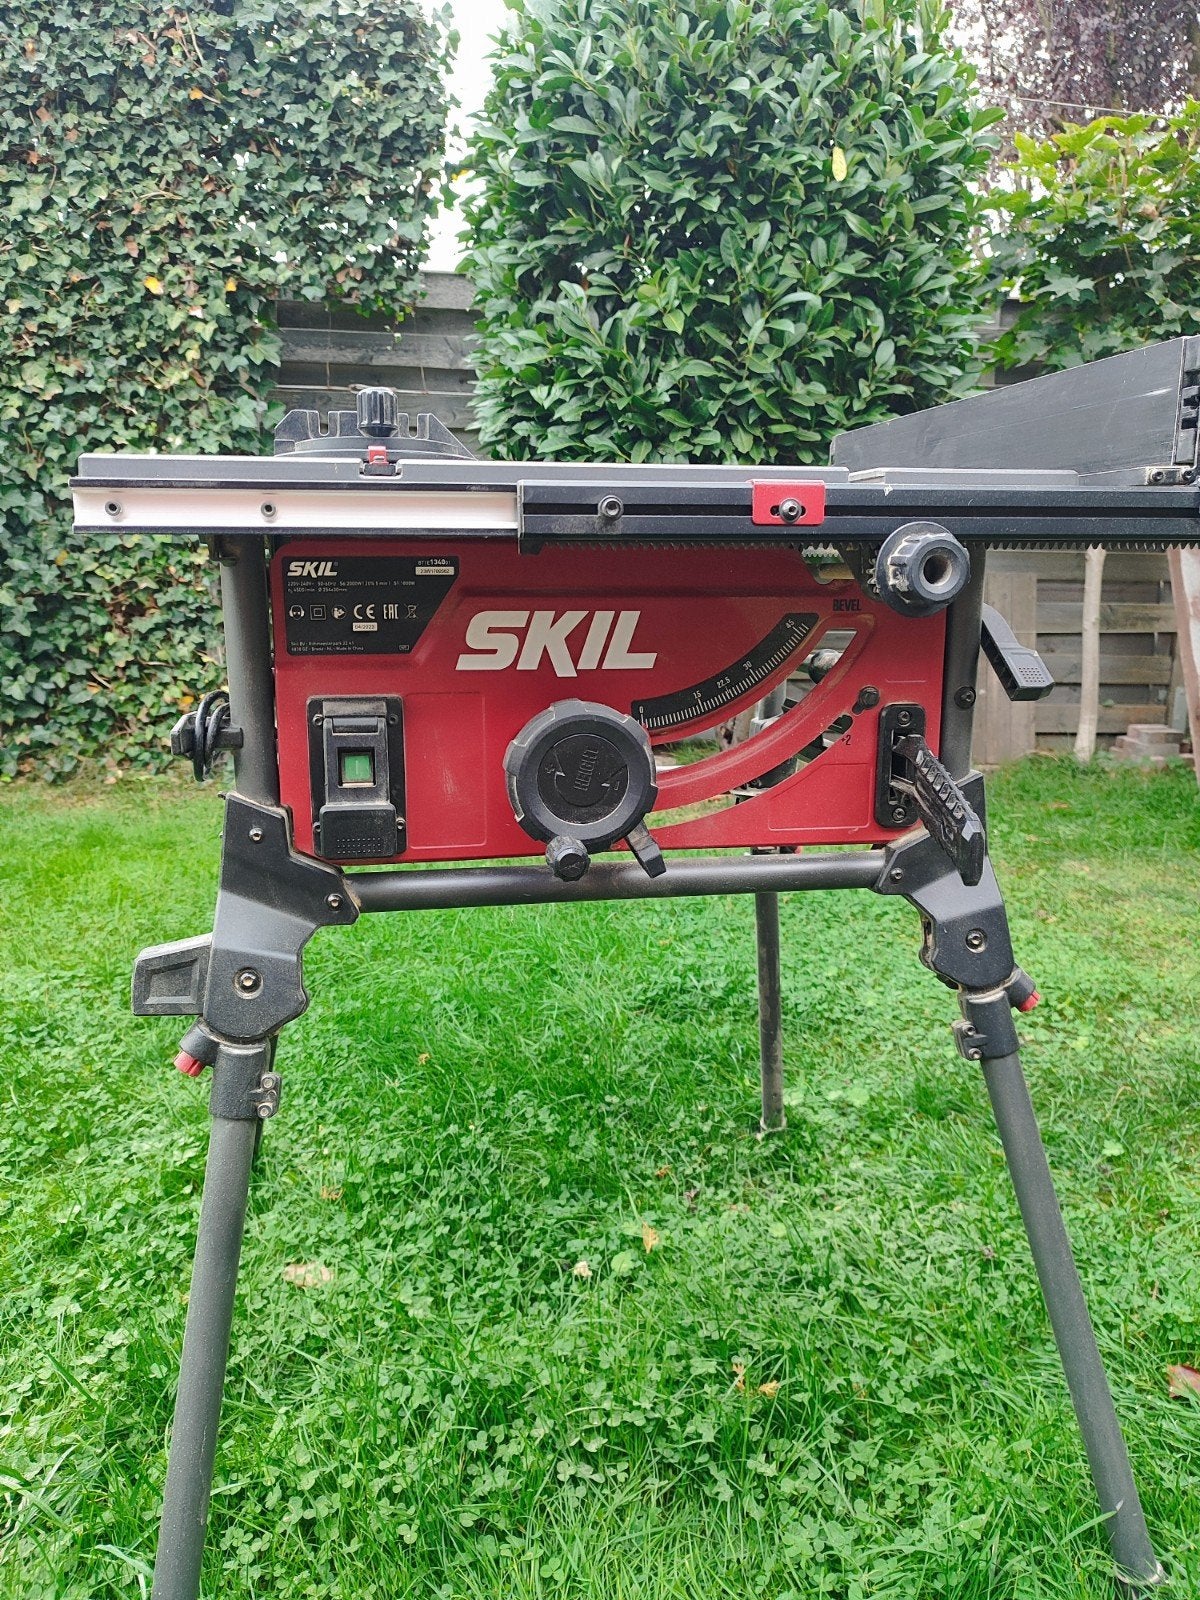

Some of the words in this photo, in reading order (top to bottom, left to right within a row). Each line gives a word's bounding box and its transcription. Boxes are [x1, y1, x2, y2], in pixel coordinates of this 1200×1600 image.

[287, 561, 337, 578] SKIL
[832, 598, 862, 612] BEVEL
[786, 619, 794, 629] 45
[455, 610, 658, 678] SKIL
[742, 660, 752, 670] 30
[716, 676, 730, 689] 22.5
[693, 690, 702, 699] 15
[638, 706, 644, 714] 0
